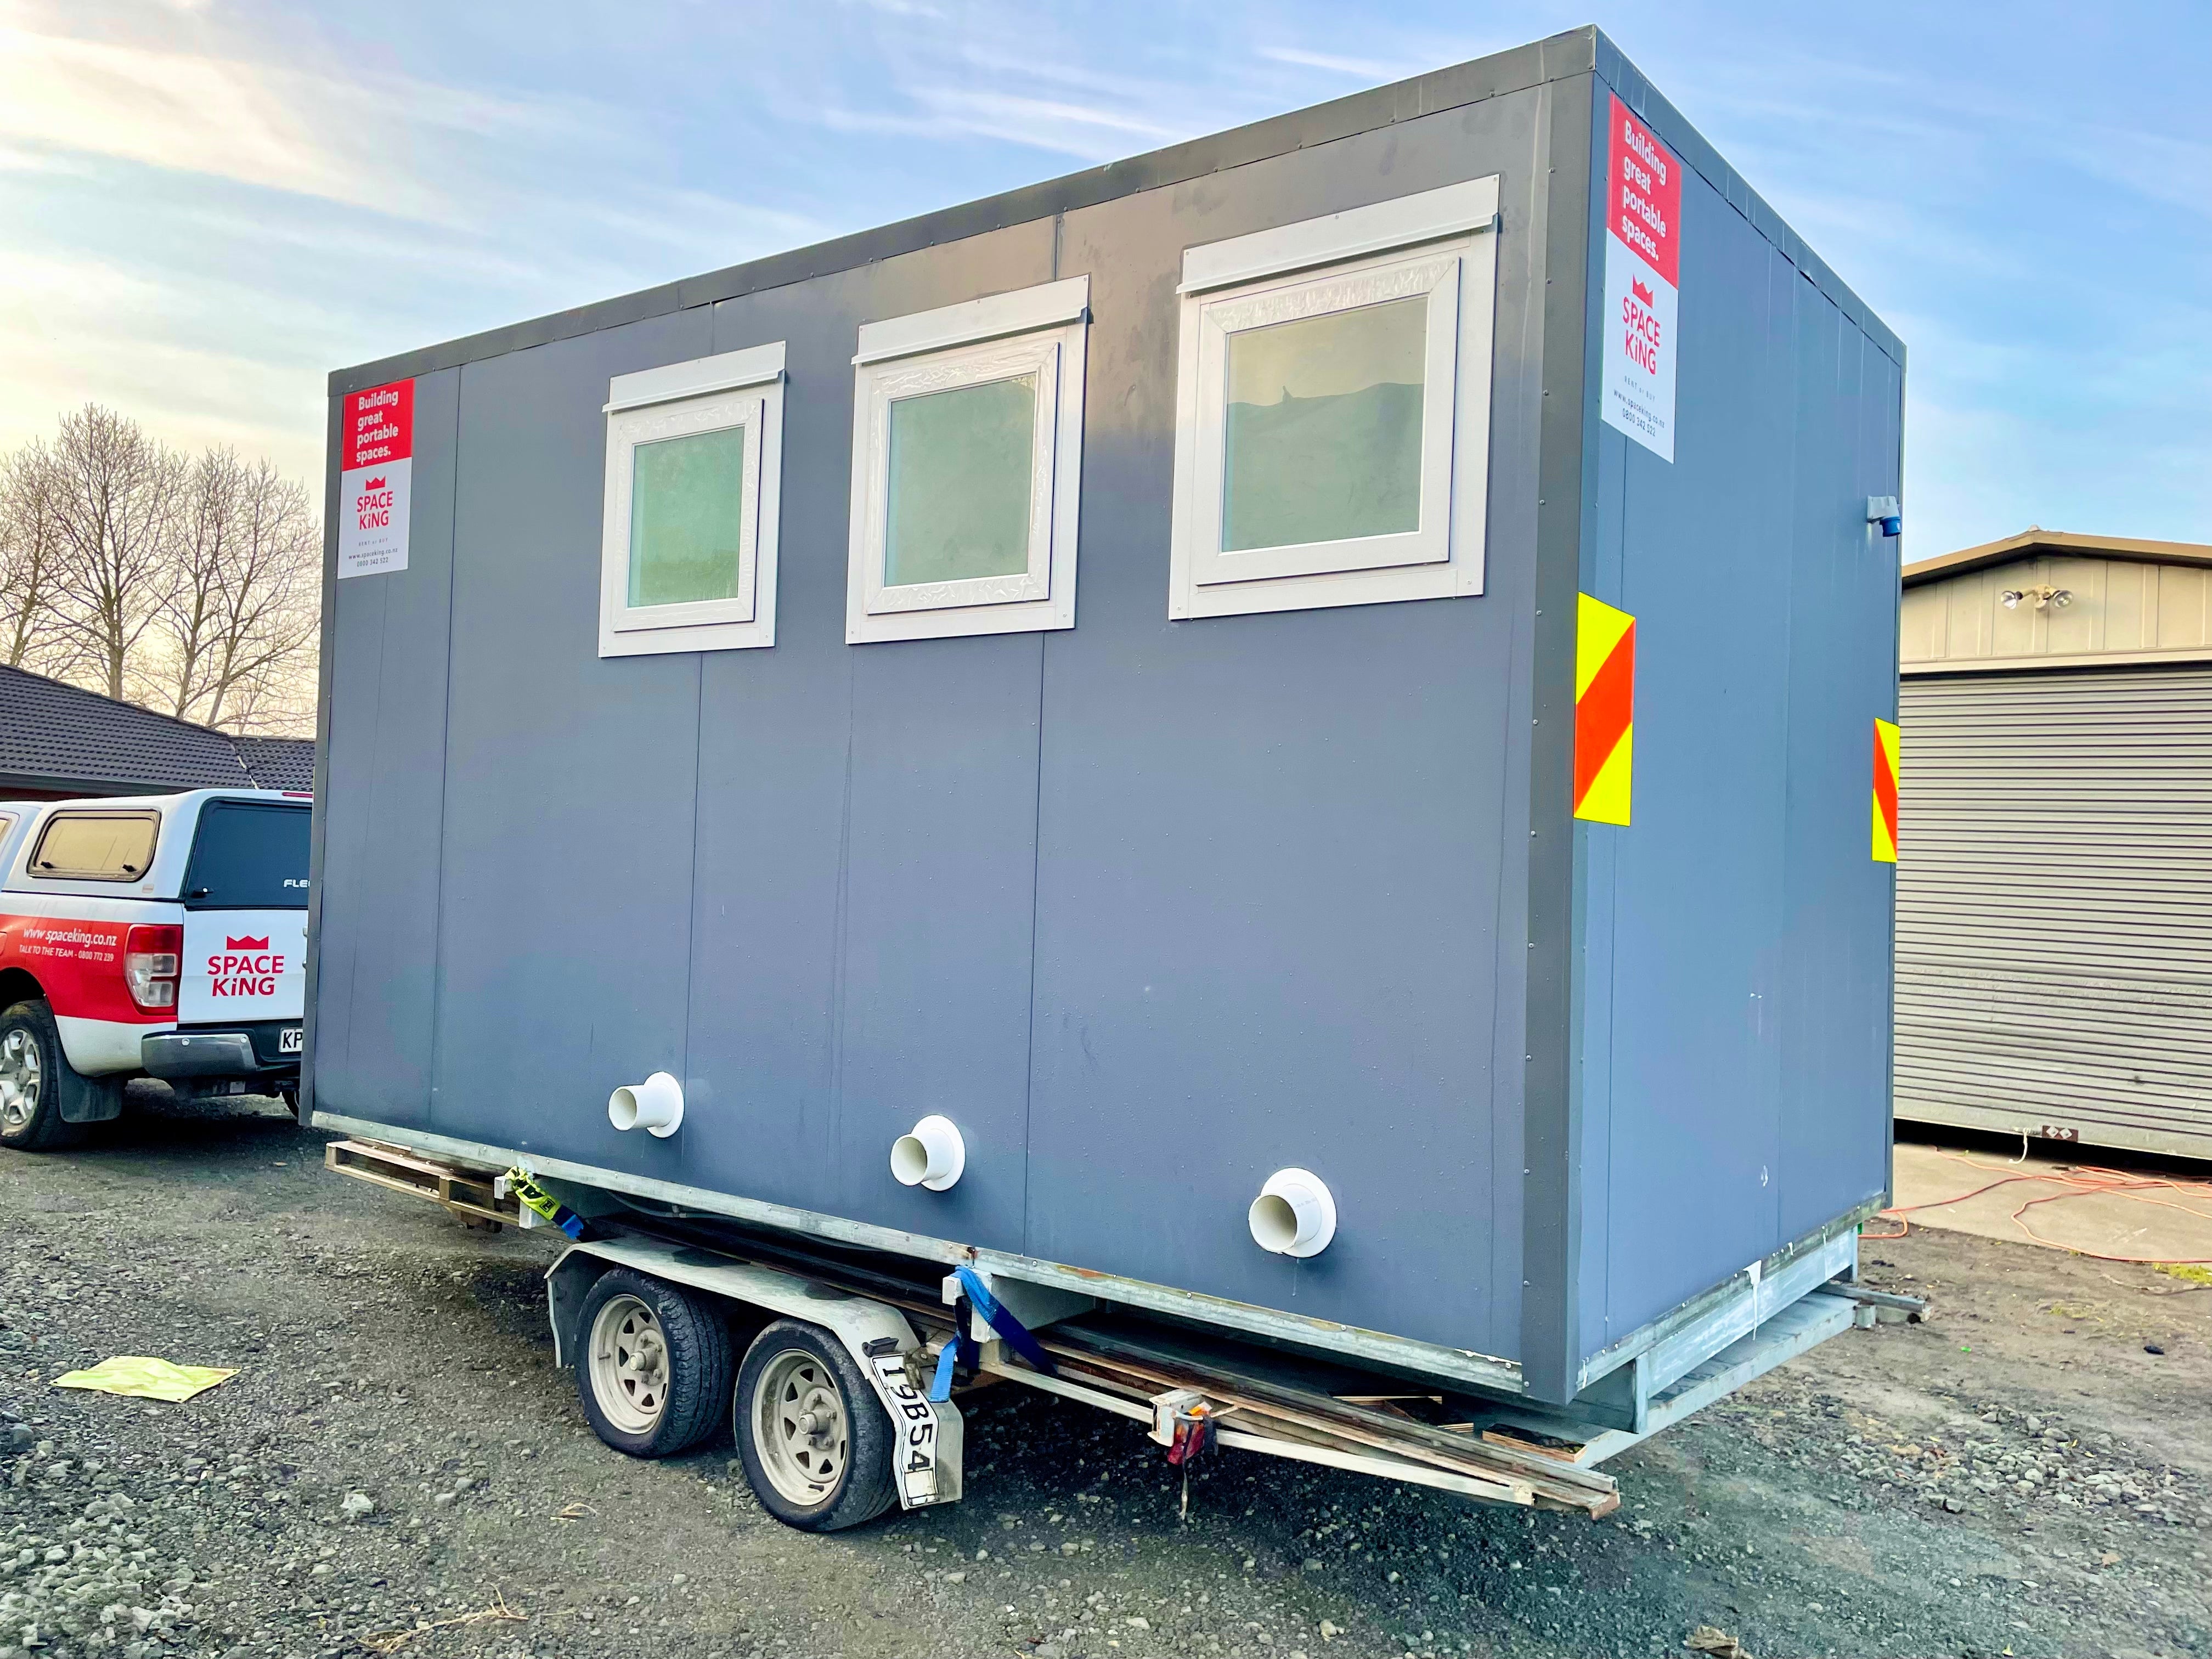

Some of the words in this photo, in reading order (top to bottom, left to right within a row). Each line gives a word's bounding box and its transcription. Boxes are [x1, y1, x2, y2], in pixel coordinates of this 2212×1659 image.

[1624, 119, 1667, 186] Building
[1623, 156, 1651, 195] great
[1623, 185, 1667, 238] portable
[1622, 215, 1659, 261] spaces.
[1623, 296, 1661, 348] SPACE
[1624, 375, 1637, 389] RENT
[358, 390, 399, 411] Building
[1613, 389, 1664, 428] www.spaceking.co.nz
[357, 410, 383, 432] great
[1623, 408, 1635, 424] 0800
[1637, 417, 1645, 431] 342
[1647, 424, 1656, 437] 522
[357, 422, 399, 449] portable
[356, 445, 391, 465] spaces.
[357, 490, 393, 512] SPACE
[348, 548, 398, 560] www.spaceking.co.nz
[283, 879, 311, 888] FLE
[19, 944, 31, 954] TALK
[33, 945, 41, 955] TO
[42, 946, 55, 956] THE
[55, 947, 74, 958] TEAM
[78, 950, 93, 960] 0800
[207, 955, 284, 975] SPACE
